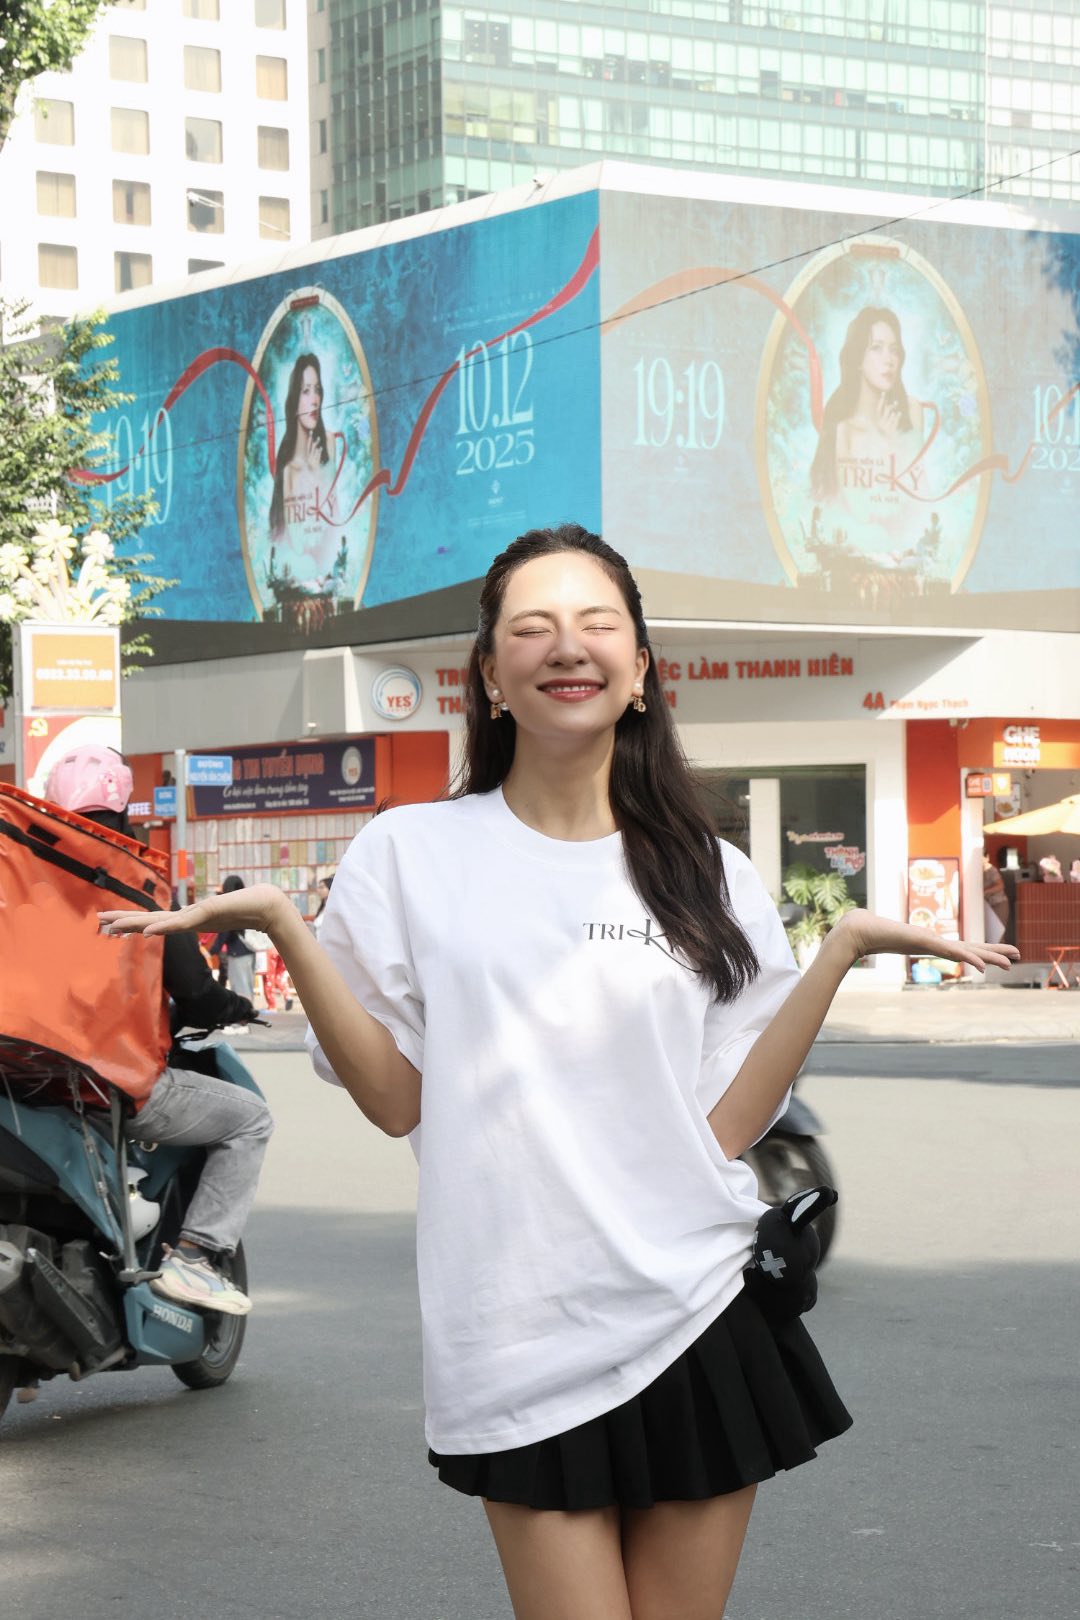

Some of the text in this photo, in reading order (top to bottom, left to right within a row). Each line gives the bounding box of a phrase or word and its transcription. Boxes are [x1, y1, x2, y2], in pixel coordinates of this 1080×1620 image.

[456, 330, 534, 435] 10.12
[632, 356, 725, 449] 19:19
[1033, 384, 1080, 445] 10.1
[456, 428, 535, 476] 2025
[1032, 447, 1080, 471] 202
[688, 656, 729, 681] LÀM
[735, 658, 800, 680] THANH
[386, 695, 412, 708] YES
[862, 692, 885, 710] 4A
[127, 802, 151, 816] OFFEE
[583, 922, 624, 940] TRI
[153, 1304, 193, 1334] HONDA
